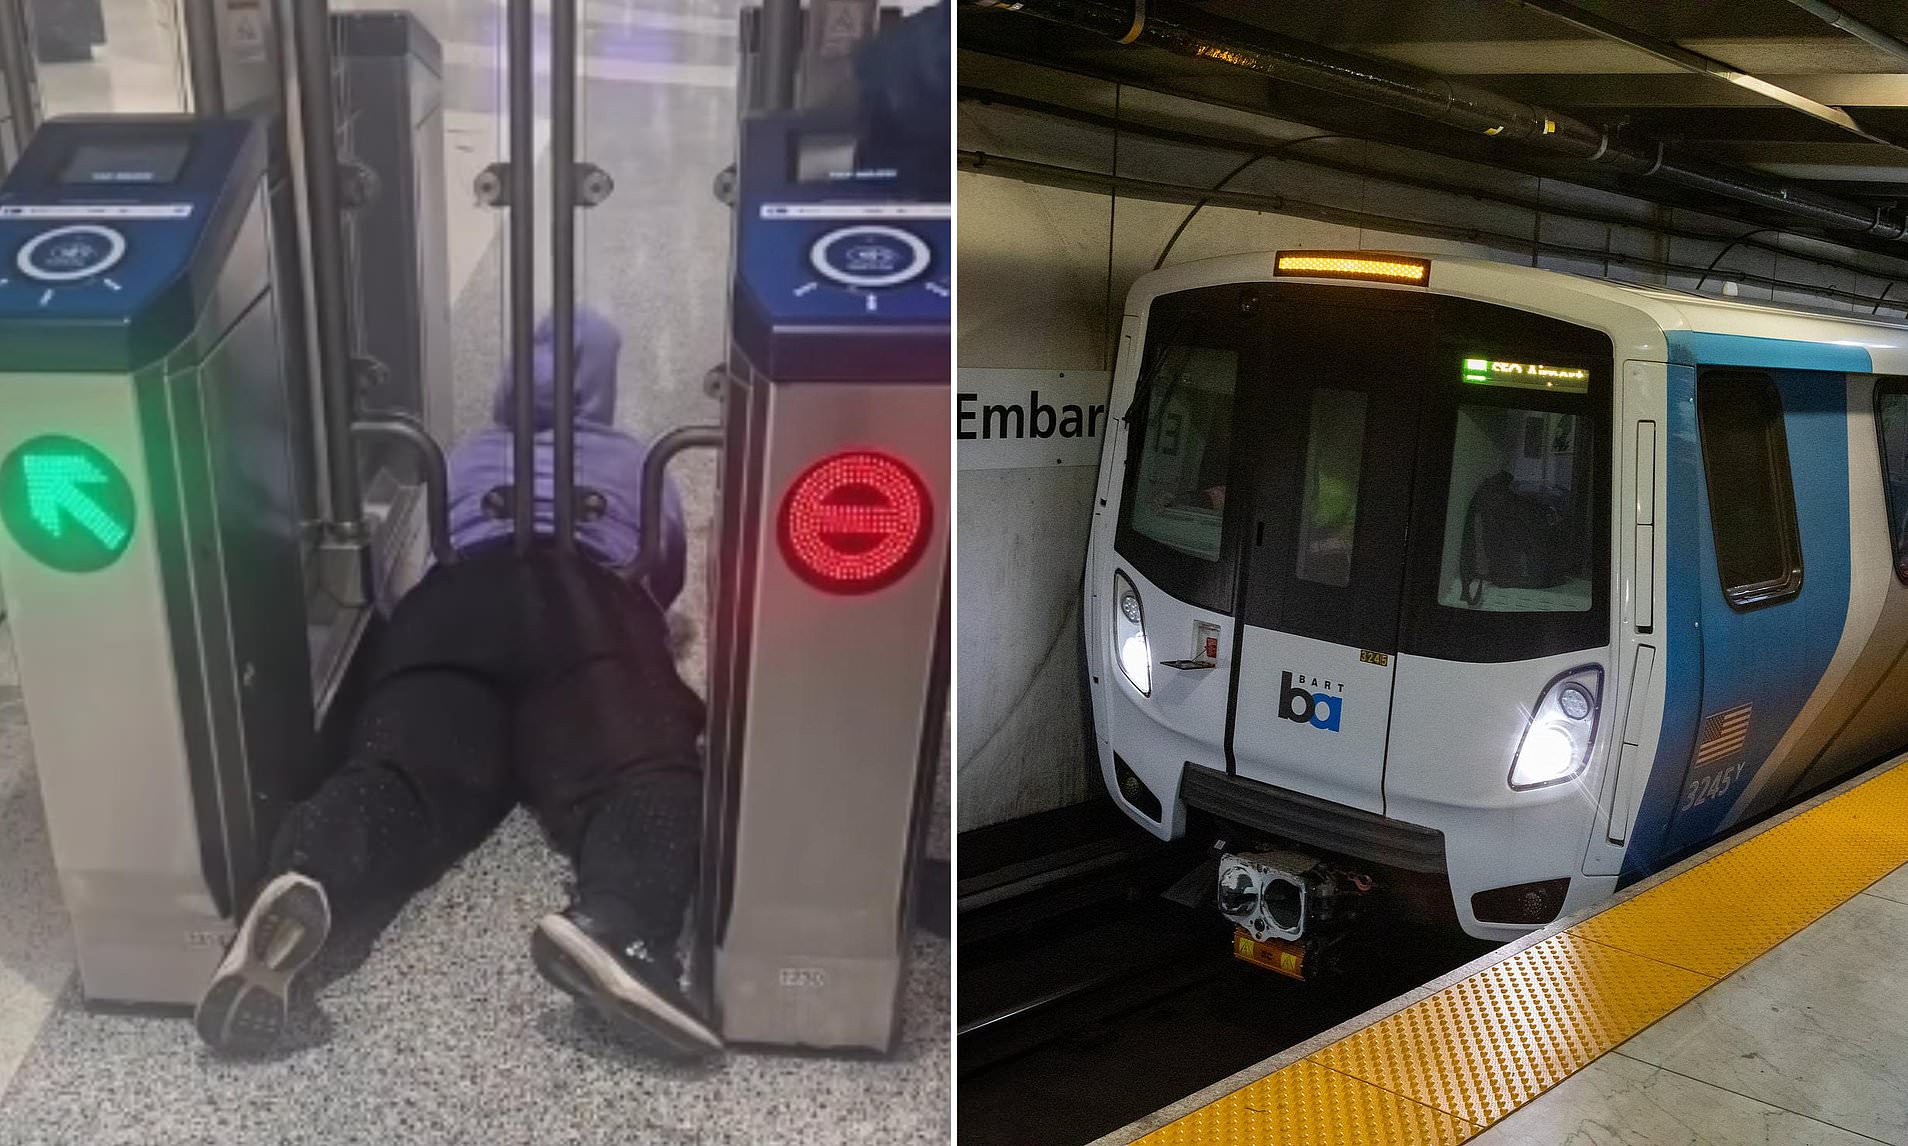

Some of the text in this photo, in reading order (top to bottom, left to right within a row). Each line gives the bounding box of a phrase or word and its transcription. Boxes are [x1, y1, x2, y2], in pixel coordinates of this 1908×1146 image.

[957, 390, 1104, 439] Embar
[1360, 650, 1388, 667] 3245
[1299, 675, 1344, 692] BART
